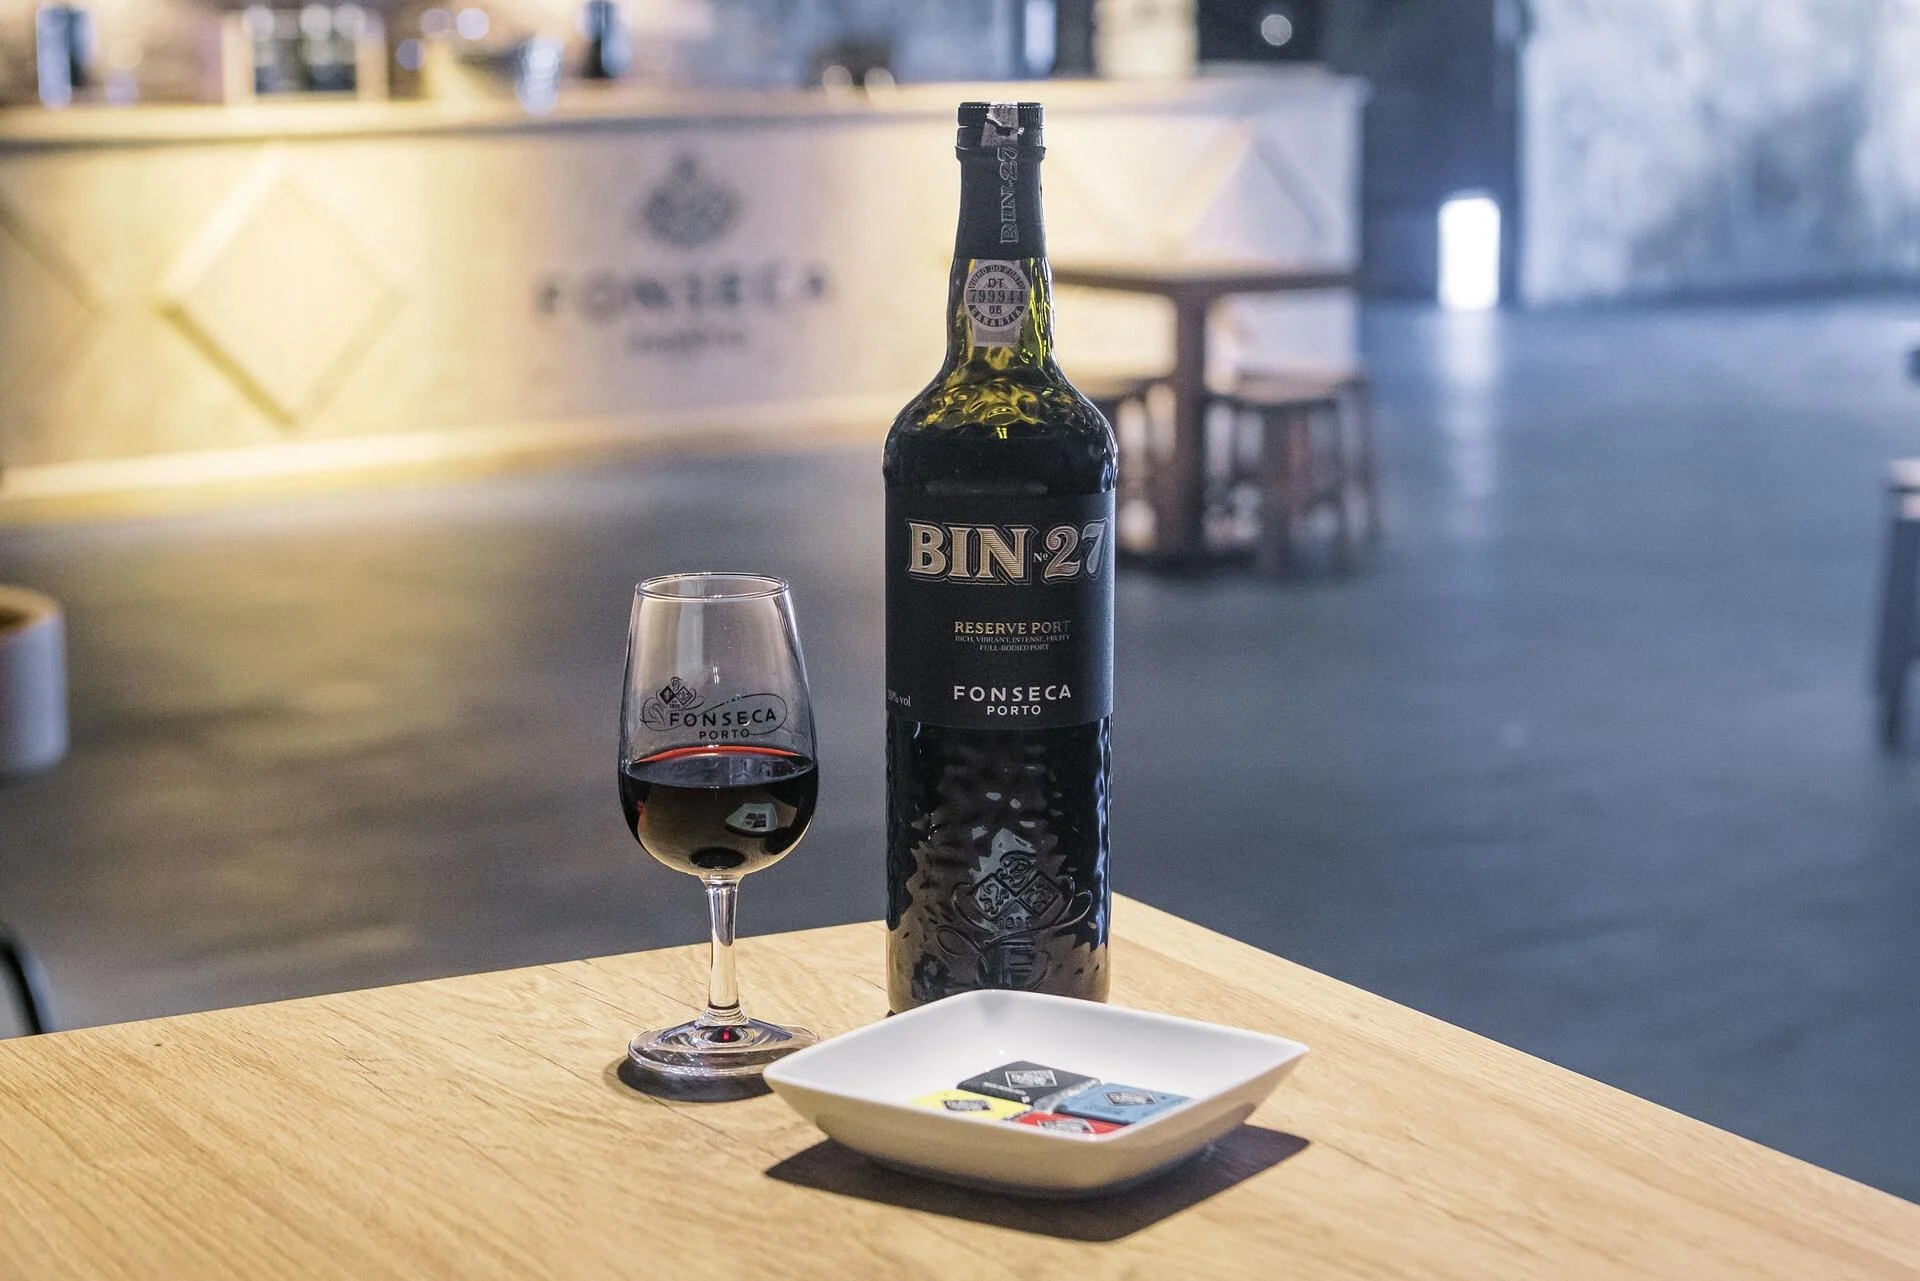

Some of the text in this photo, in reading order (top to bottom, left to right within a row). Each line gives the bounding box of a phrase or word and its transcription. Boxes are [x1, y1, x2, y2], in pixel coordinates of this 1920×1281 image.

[1000, 186, 1019, 243] BIN
[906, 519, 1038, 585] BIN
[1042, 517, 1108, 584] 27
[954, 620, 1071, 634] RESERVE PORT
[954, 684, 1071, 701] FONSECA
[669, 708, 777, 728] FONSECA
[987, 704, 1041, 715] PORTO
[699, 728, 750, 740] PORTO
